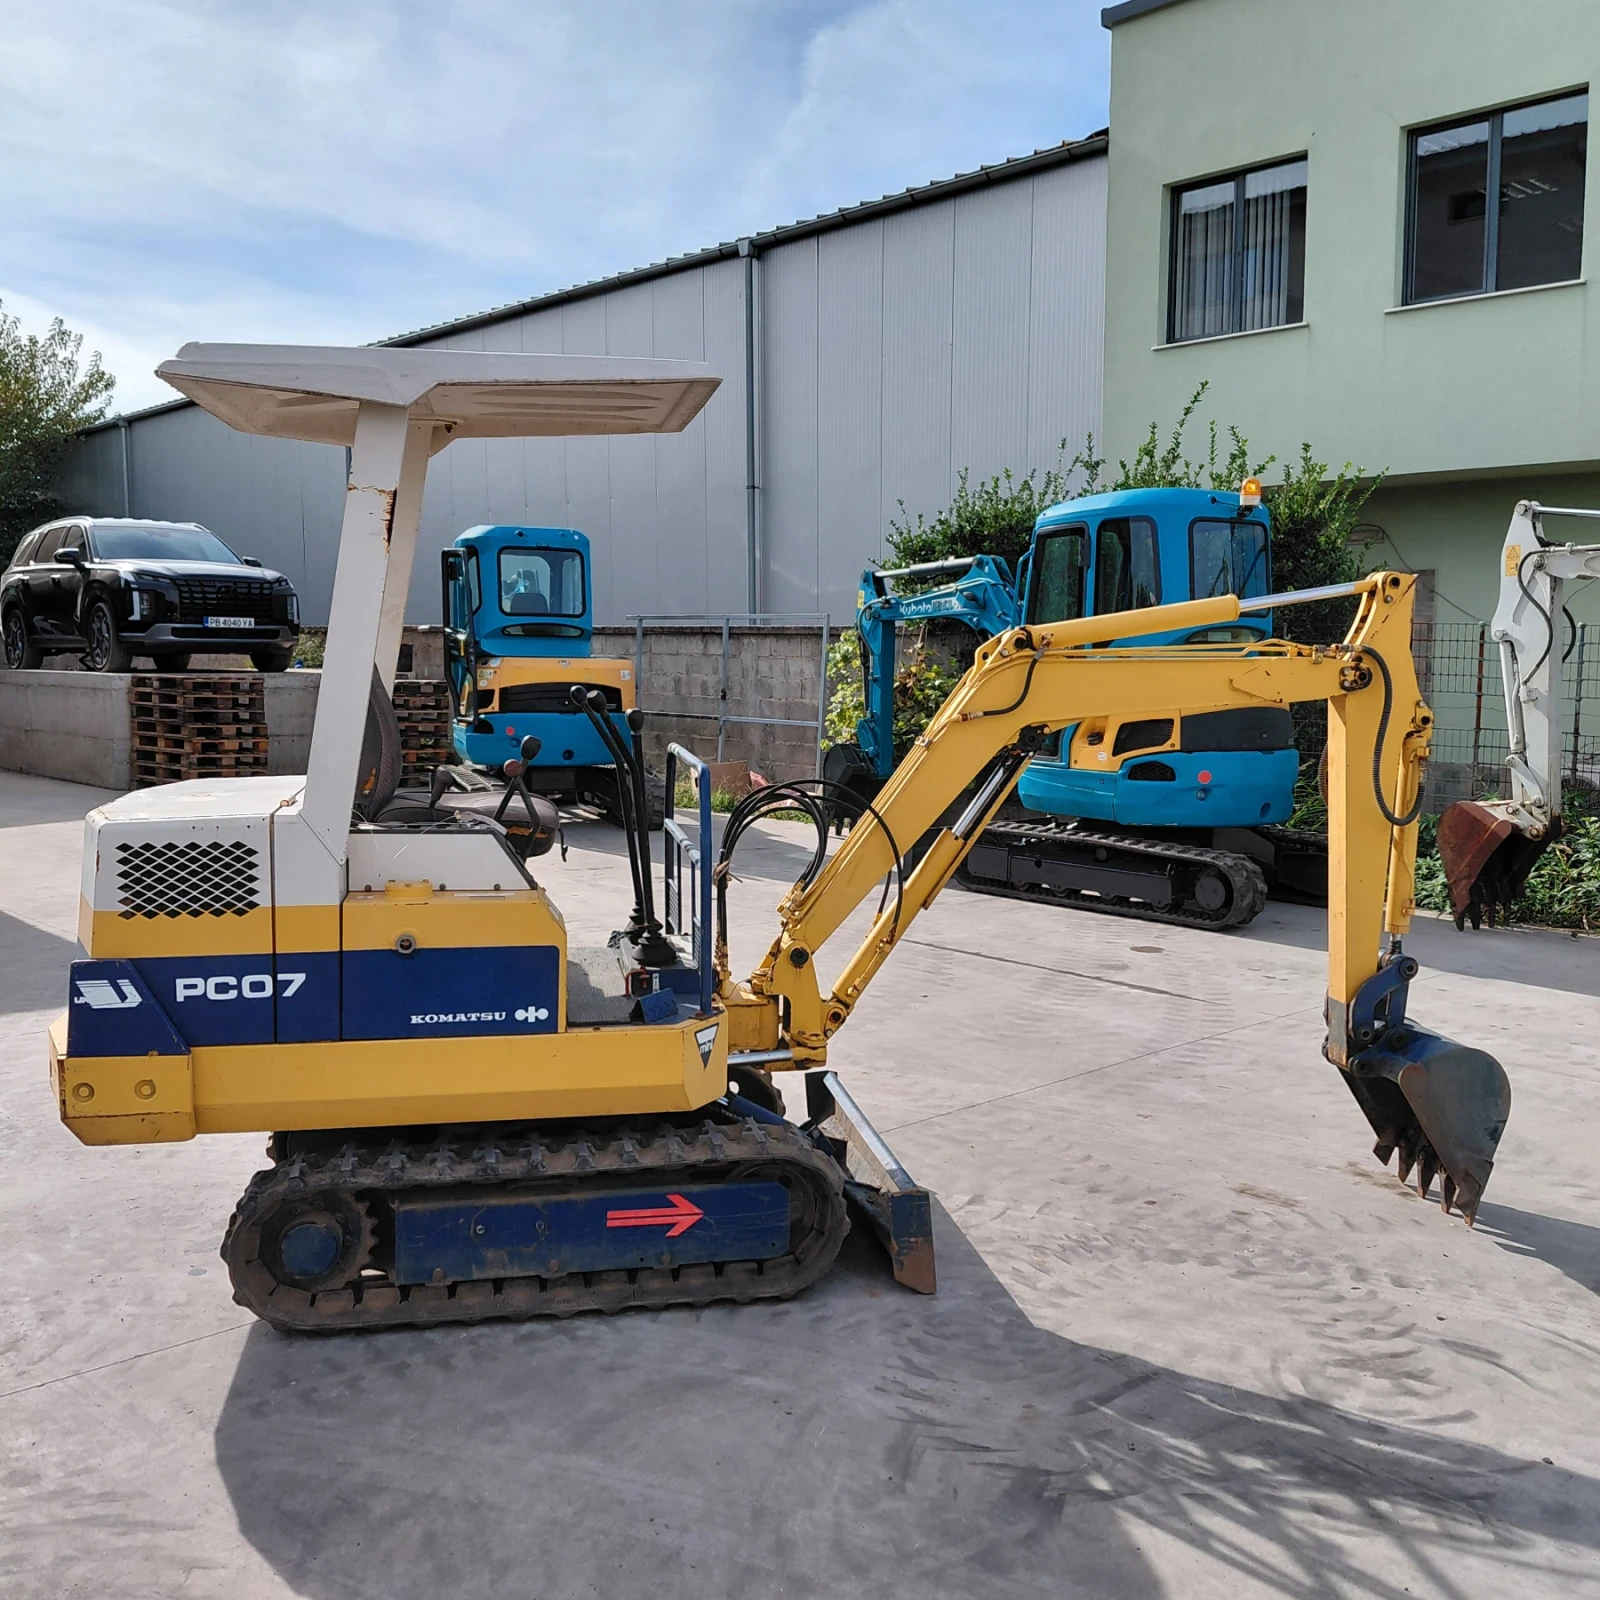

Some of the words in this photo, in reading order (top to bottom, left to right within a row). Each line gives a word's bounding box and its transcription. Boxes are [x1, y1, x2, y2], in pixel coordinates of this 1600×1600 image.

[899, 602, 931, 615] Kubota
[210, 618, 221, 627] PB
[222, 618, 242, 627] 4040
[243, 619, 253, 628] YA
[410, 1012, 506, 1024] KOMATSU
